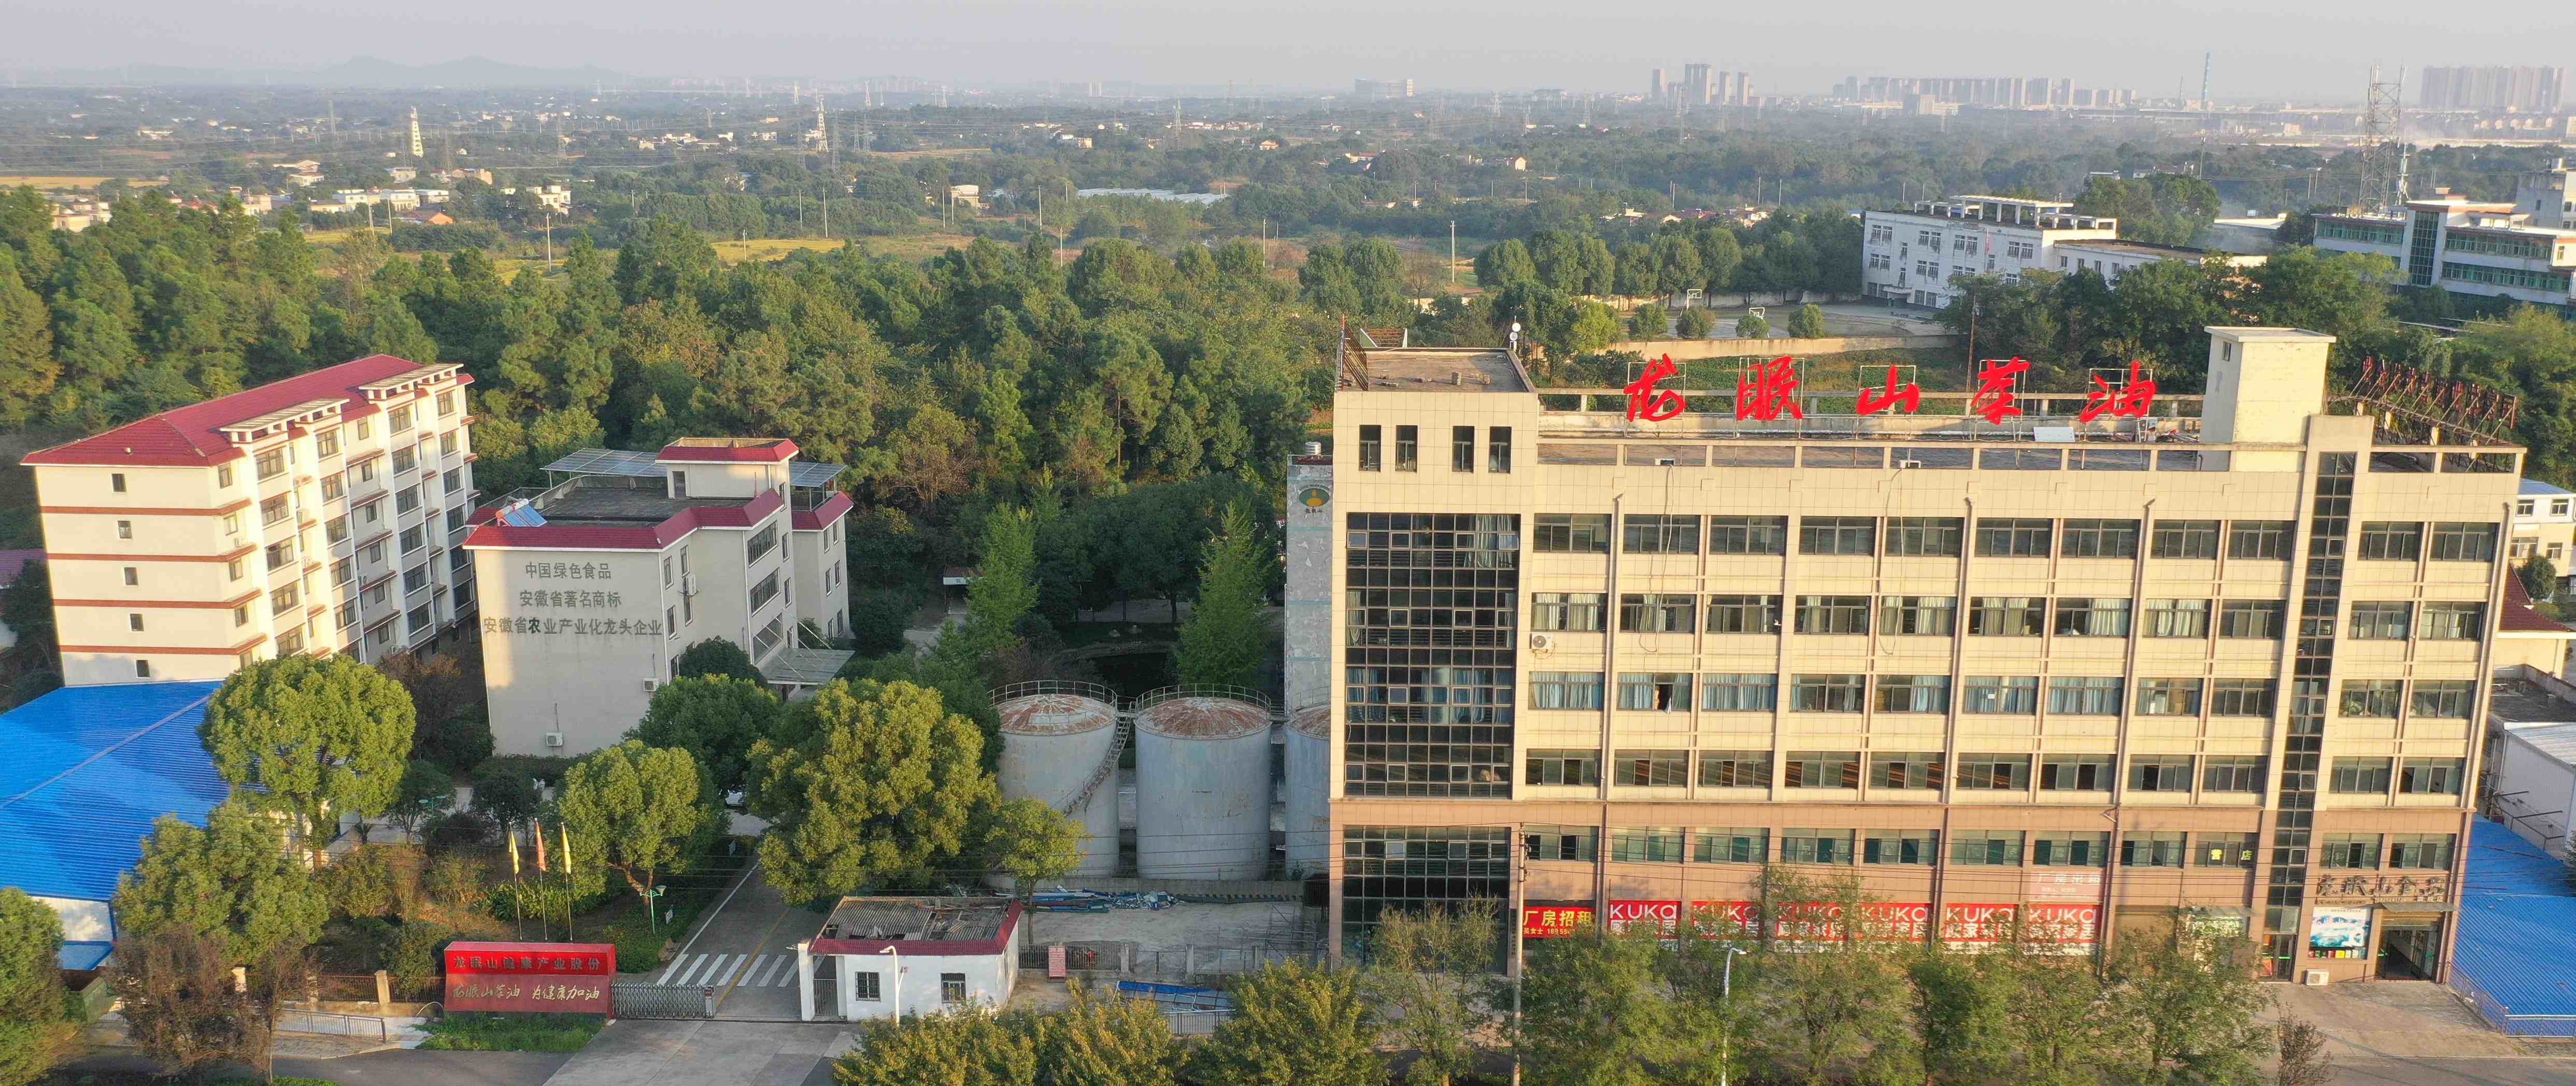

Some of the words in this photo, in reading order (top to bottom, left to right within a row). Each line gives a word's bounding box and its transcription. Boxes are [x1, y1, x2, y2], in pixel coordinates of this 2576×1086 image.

[525, 562, 611, 579] 中国绿色食品
[520, 590, 621, 608] 安徽省著名商标
[484, 616, 662, 635] 安徽省农业产业化龙头企业
[1524, 910, 1592, 926] 厂房招租
[531, 984, 600, 1001] 为健康加油
